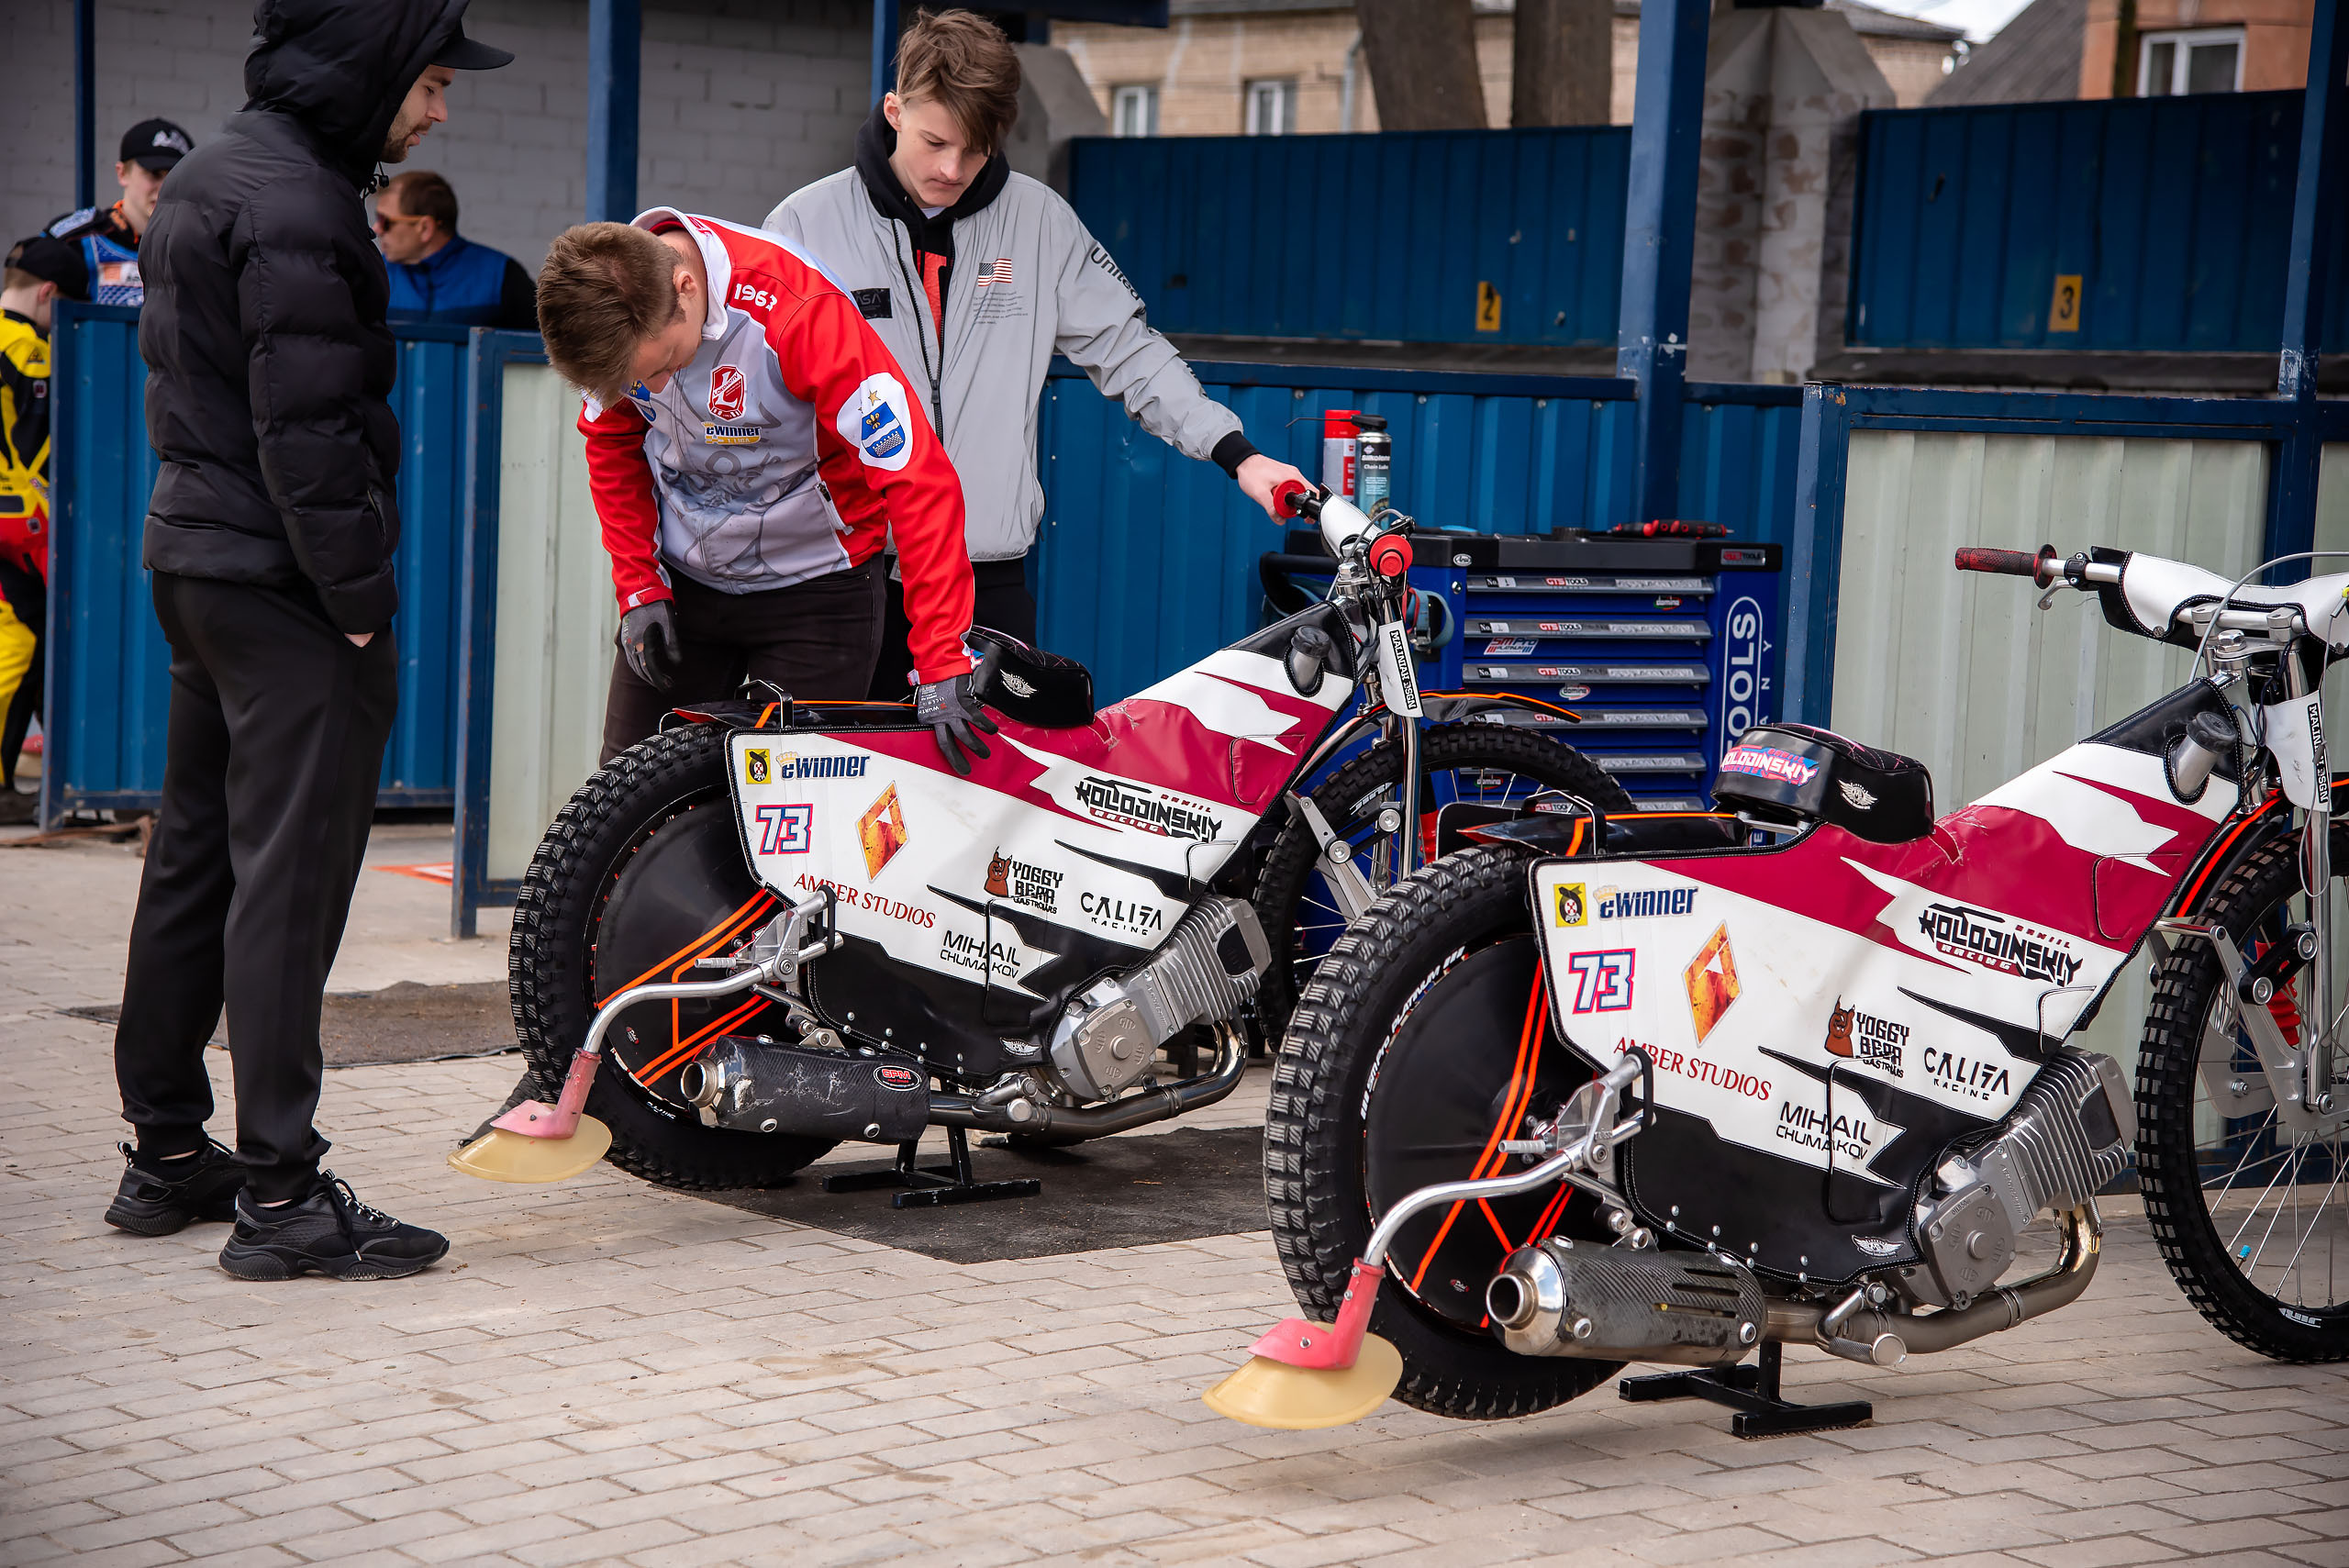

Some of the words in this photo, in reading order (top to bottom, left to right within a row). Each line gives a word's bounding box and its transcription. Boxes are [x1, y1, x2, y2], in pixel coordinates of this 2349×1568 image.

[734, 284, 778, 312] 1963
[854, 293, 881, 305] ASA
[2060, 284, 2075, 320] 3
[706, 425, 762, 437] eWinner
[1727, 612, 1757, 753] OOLS
[781, 755, 870, 779] eWinner
[1161, 794, 1211, 813] DANIIL
[755, 804, 813, 855] 73
[1094, 809, 1160, 832] RACING
[1012, 861, 1063, 888] YOGGY
[862, 893, 936, 929] STUDIOS
[1600, 887, 1698, 919] eWinner
[1091, 917, 1148, 936] RACING
[2015, 925, 2071, 949] DANIIL
[942, 930, 1021, 967] MIHAIL
[1942, 944, 2012, 970] RACING
[940, 950, 1019, 979] CHUMAKOV
[1568, 948, 1636, 1015] 73
[1391, 964, 1442, 1033] PLATINUM
[1856, 1012, 1909, 1046] YOGGY
[882, 1069, 911, 1080] GPM
[1687, 1058, 1772, 1101] STUDIOS
[1933, 1078, 1990, 1101] RACING
[1780, 1101, 1872, 1145] MIHAIL
[1776, 1125, 1868, 1161] CHUMAKOV
